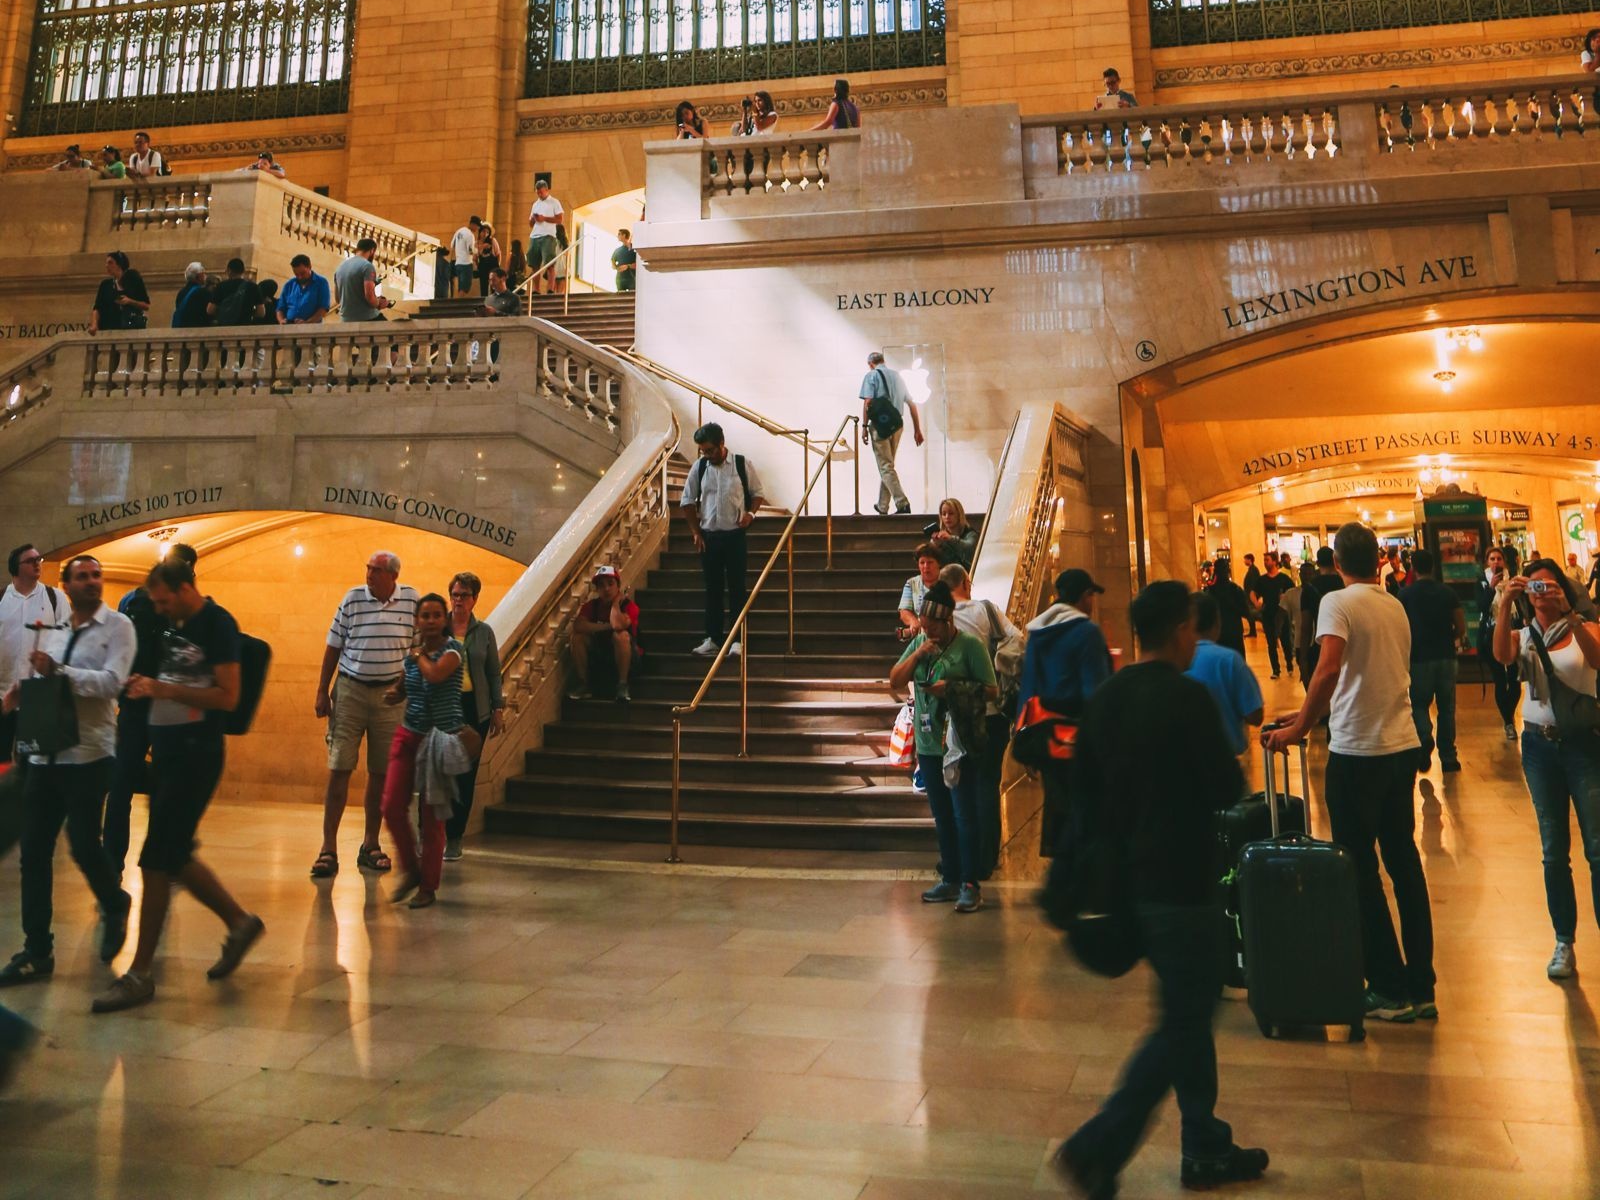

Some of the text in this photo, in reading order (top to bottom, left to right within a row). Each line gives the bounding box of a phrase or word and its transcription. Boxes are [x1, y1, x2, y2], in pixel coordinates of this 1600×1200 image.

[837, 288, 995, 310] EAST BALCONY
[1221, 255, 1478, 329] LEXINGTON AVE
[1242, 430, 1461, 476] 42ND STREET PASSAGE
[1473, 430, 1561, 447] SUBWAY
[1328, 478, 1402, 494] LEXINGTON
[77, 487, 223, 531] TRACKS 100 TO 117
[325, 486, 517, 547] DINING CONCOURSE
